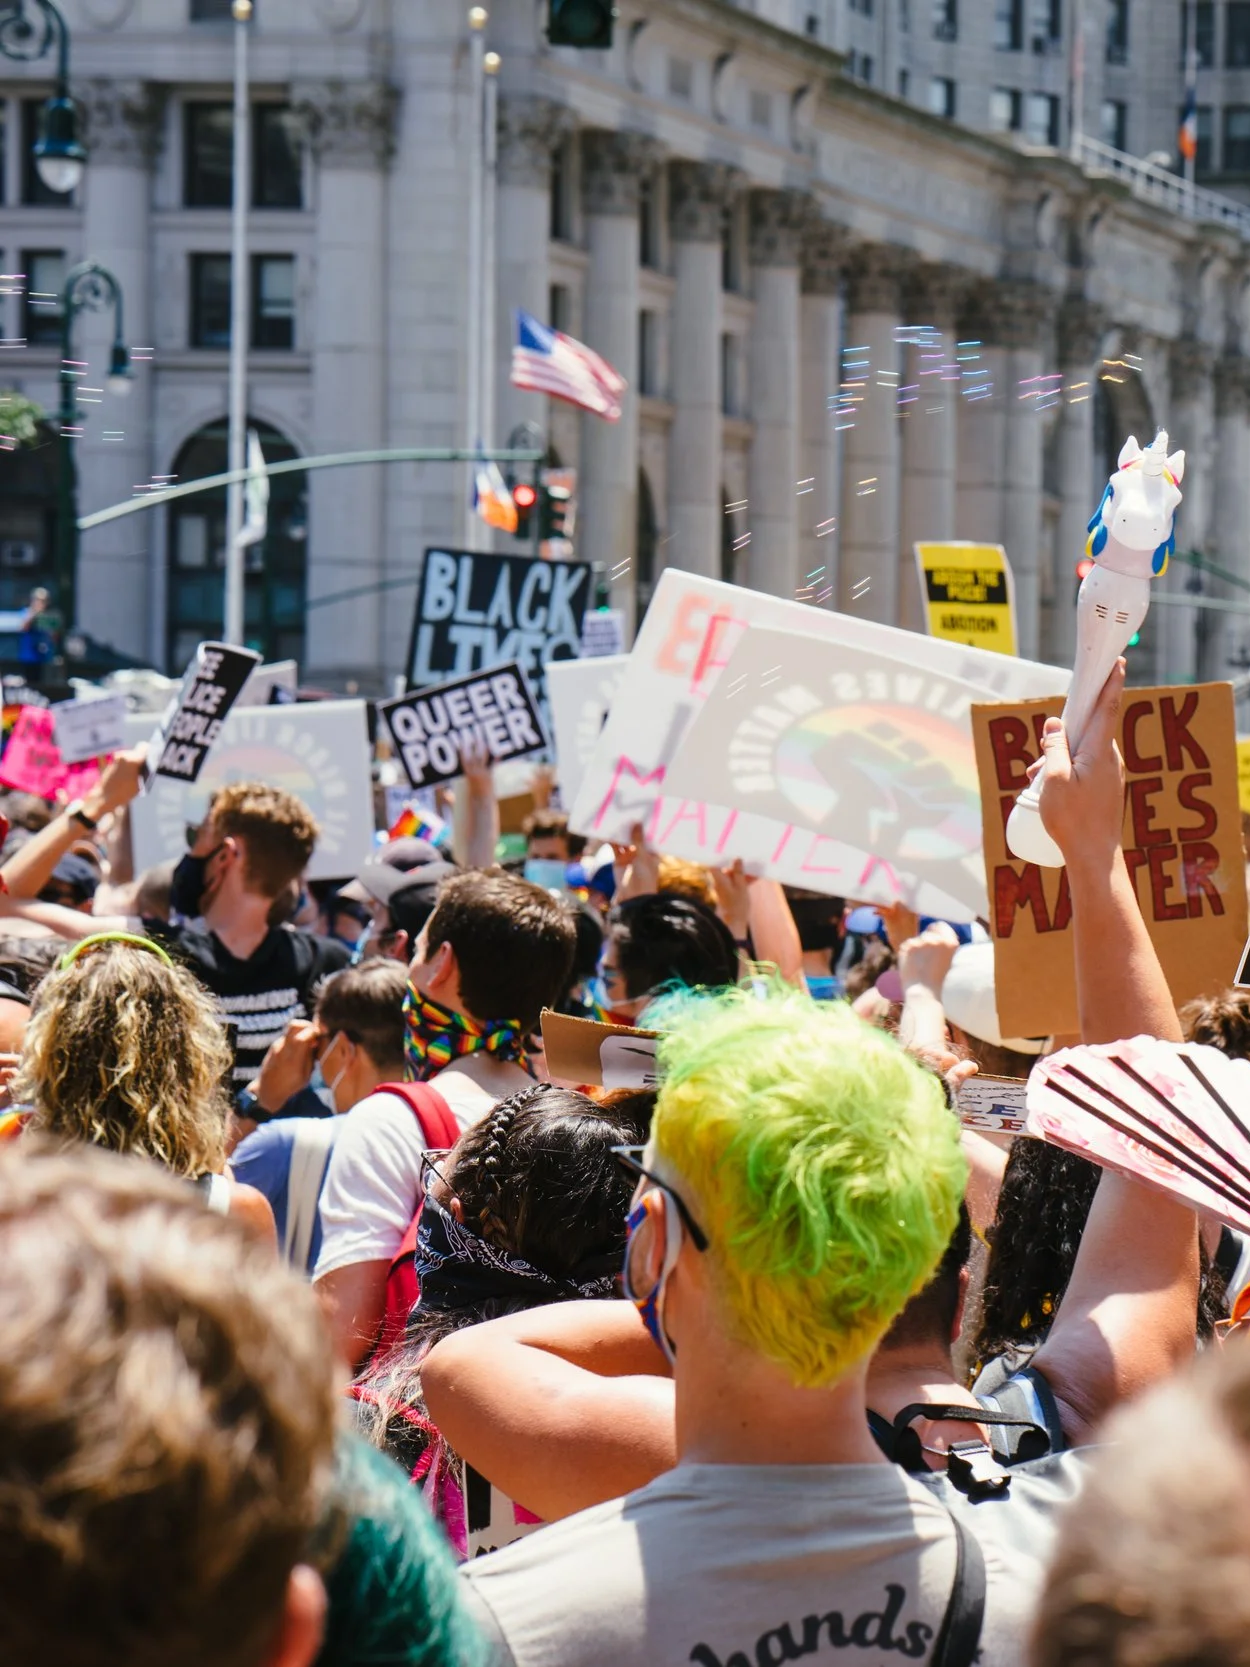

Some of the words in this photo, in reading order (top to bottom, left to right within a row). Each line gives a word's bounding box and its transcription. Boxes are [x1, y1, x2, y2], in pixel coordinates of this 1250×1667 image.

[422, 551, 587, 638] BLACK
[391, 672, 527, 743] QUEER
[402, 708, 541, 784] POWER
[988, 691, 1211, 791] BCK
